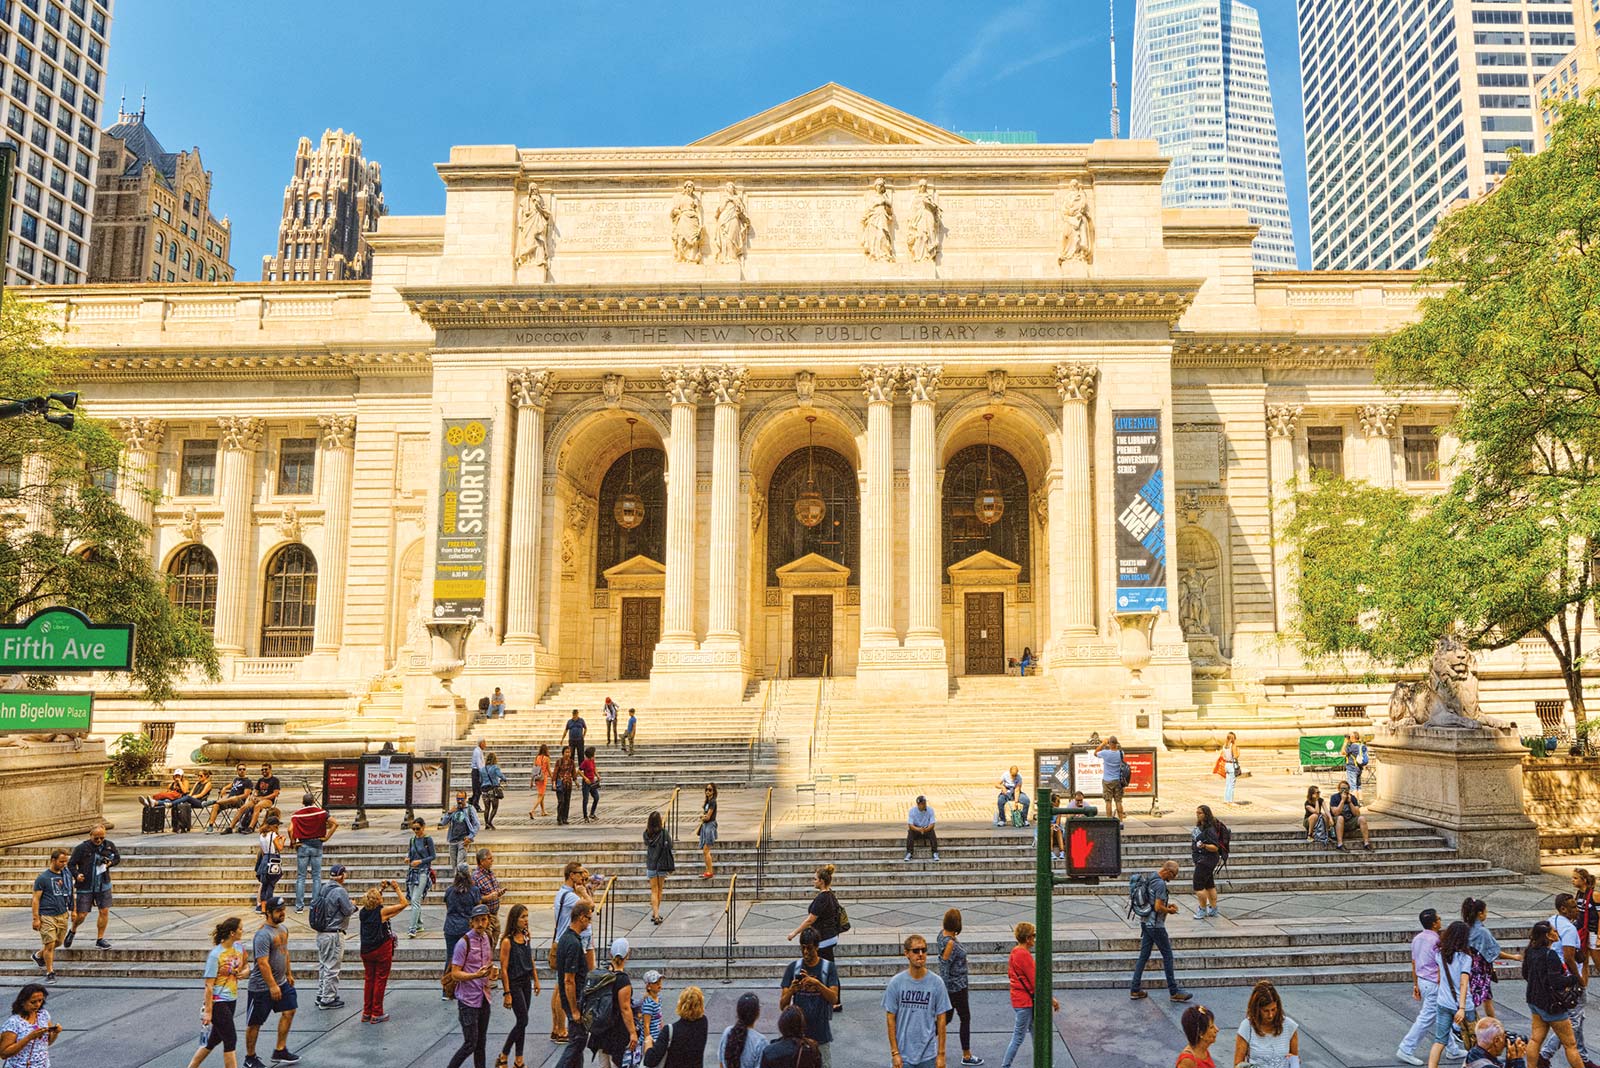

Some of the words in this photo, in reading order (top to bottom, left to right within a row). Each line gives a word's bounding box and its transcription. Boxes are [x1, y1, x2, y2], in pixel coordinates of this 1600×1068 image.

[564, 202, 581, 212] THE
[589, 202, 619, 212] ASTOR
[624, 202, 666, 212] LIBRARY
[754, 200, 772, 209] THE
[778, 200, 811, 210] LENOX
[816, 200, 858, 210] LIBRARY
[944, 199, 964, 208] THE
[974, 199, 1008, 208] TILDEN
[1016, 198, 1048, 208] TRUST
[516, 332, 588, 344] MDCCCXCV
[628, 328, 668, 343] THE
[683, 328, 730, 342] NEW
[748, 327, 797, 342] YORK
[814, 326, 882, 342] PUBLIC
[900, 326, 980, 340] LIBRARY
[1116, 417, 1133, 429] LIVE
[1136, 417, 1158, 429] NYPL
[1116, 436, 1127, 444] THE
[1128, 436, 1156, 444] LIBRARY'S
[1116, 446, 1141, 454] PREMIER
[1117, 456, 1158, 464] CONVERSATION
[1117, 466, 1136, 474] SERIES
[458, 448, 486, 534] SHORTS
[444, 491, 457, 534] SUMMER
[4, 637, 54, 659] Fifth
[62, 638, 105, 659] Ave
[0, 703, 16, 718] hn
[20, 703, 65, 722] Bigelow
[67, 708, 87, 718] Plaza
[902, 990, 930, 1002] LOYOLA
